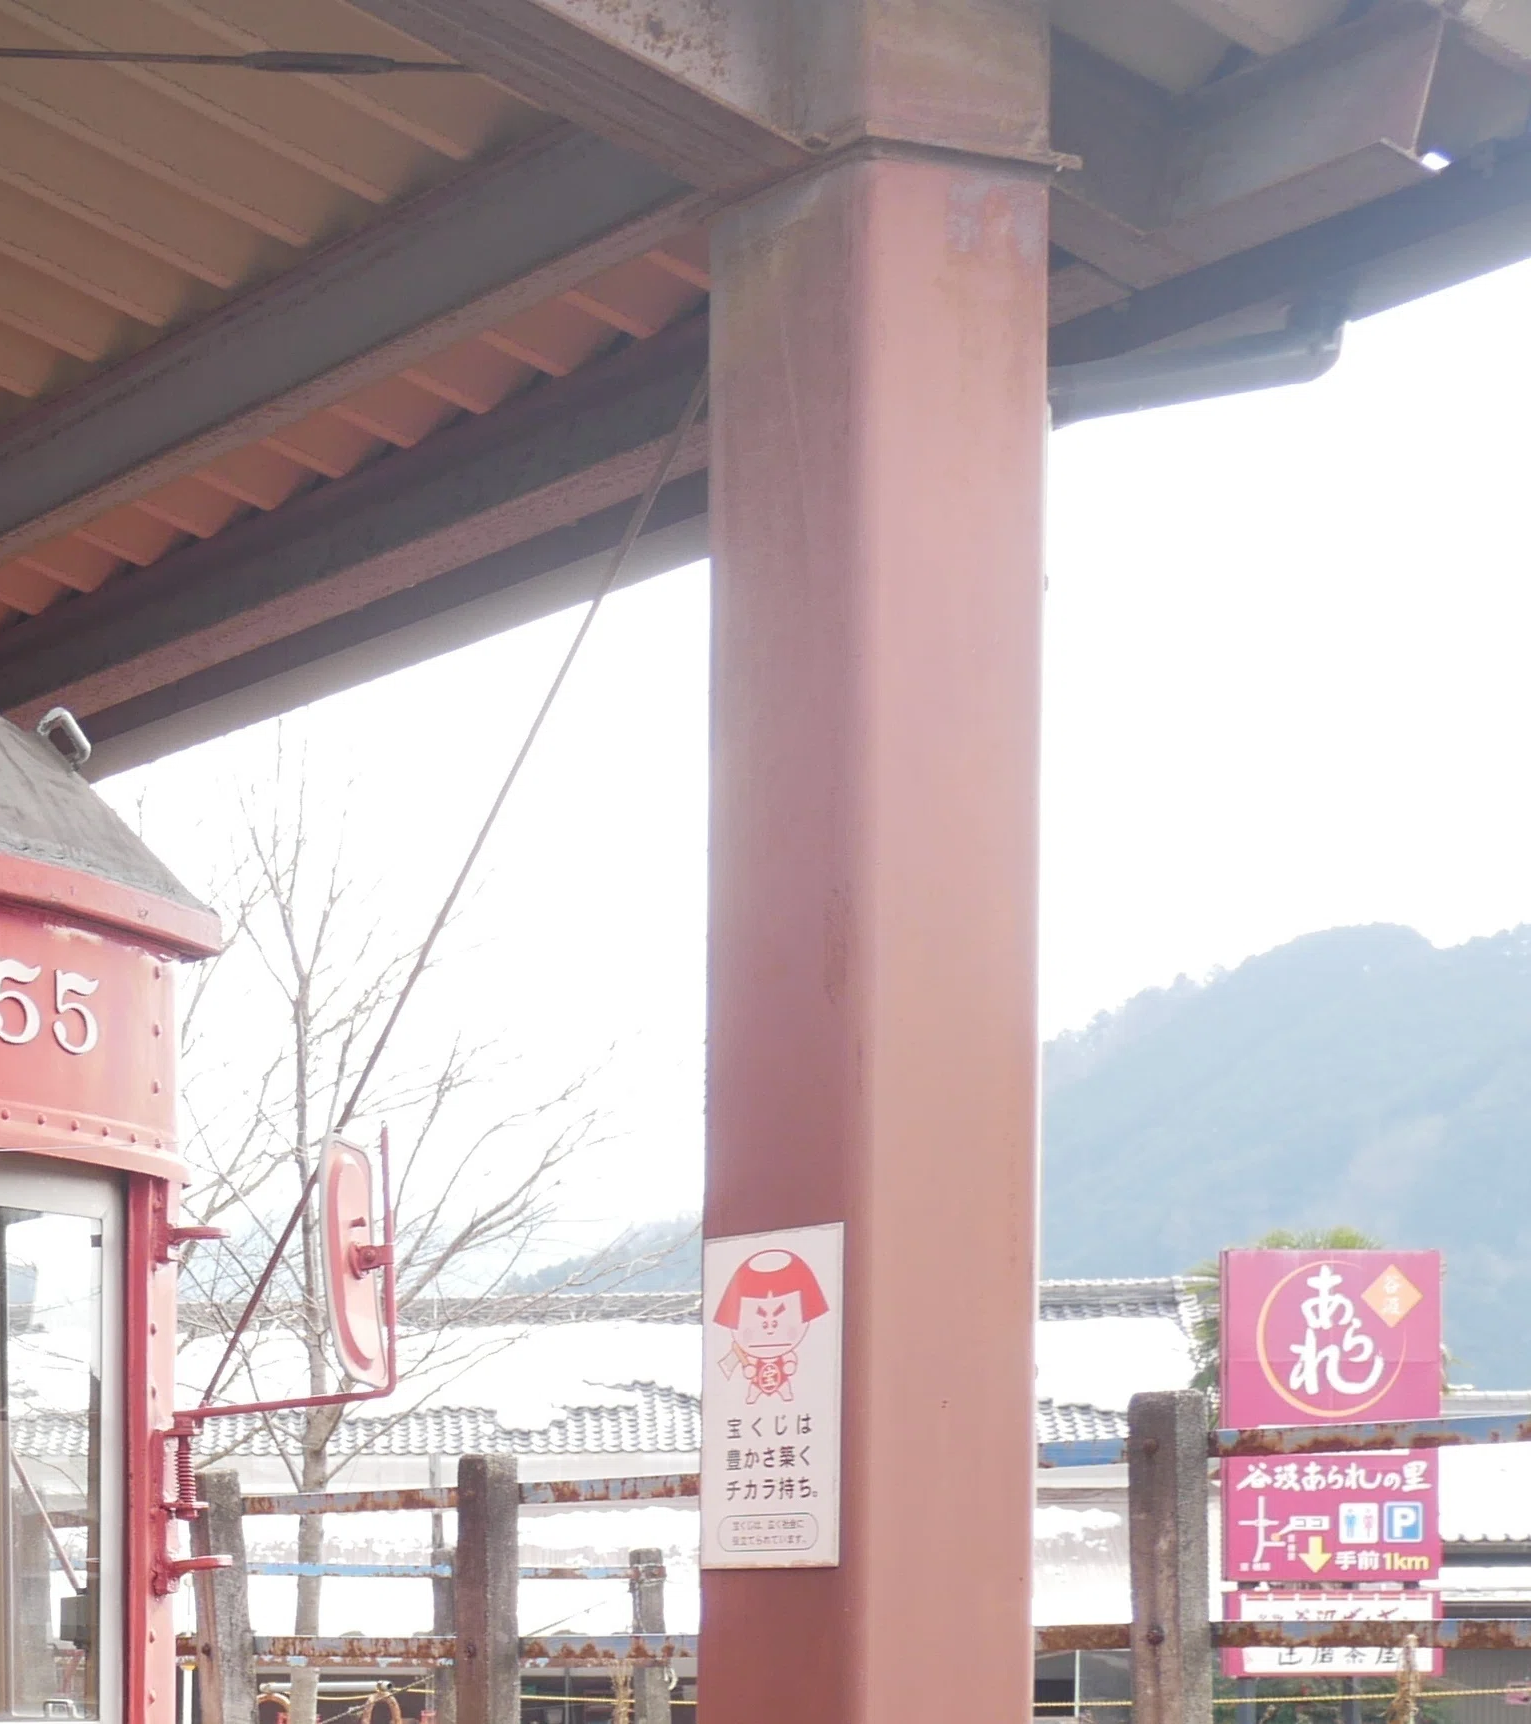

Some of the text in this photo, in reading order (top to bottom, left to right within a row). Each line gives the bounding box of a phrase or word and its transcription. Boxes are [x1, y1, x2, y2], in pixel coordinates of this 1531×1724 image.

[1289, 1264, 1385, 1395] あられ
[726, 1413, 813, 1440] 宝くじは
[726, 1445, 812, 1471] 豊かさ築く
[726, 1476, 819, 1501] チカラ持ち。
[1392, 1506, 1417, 1538] P
